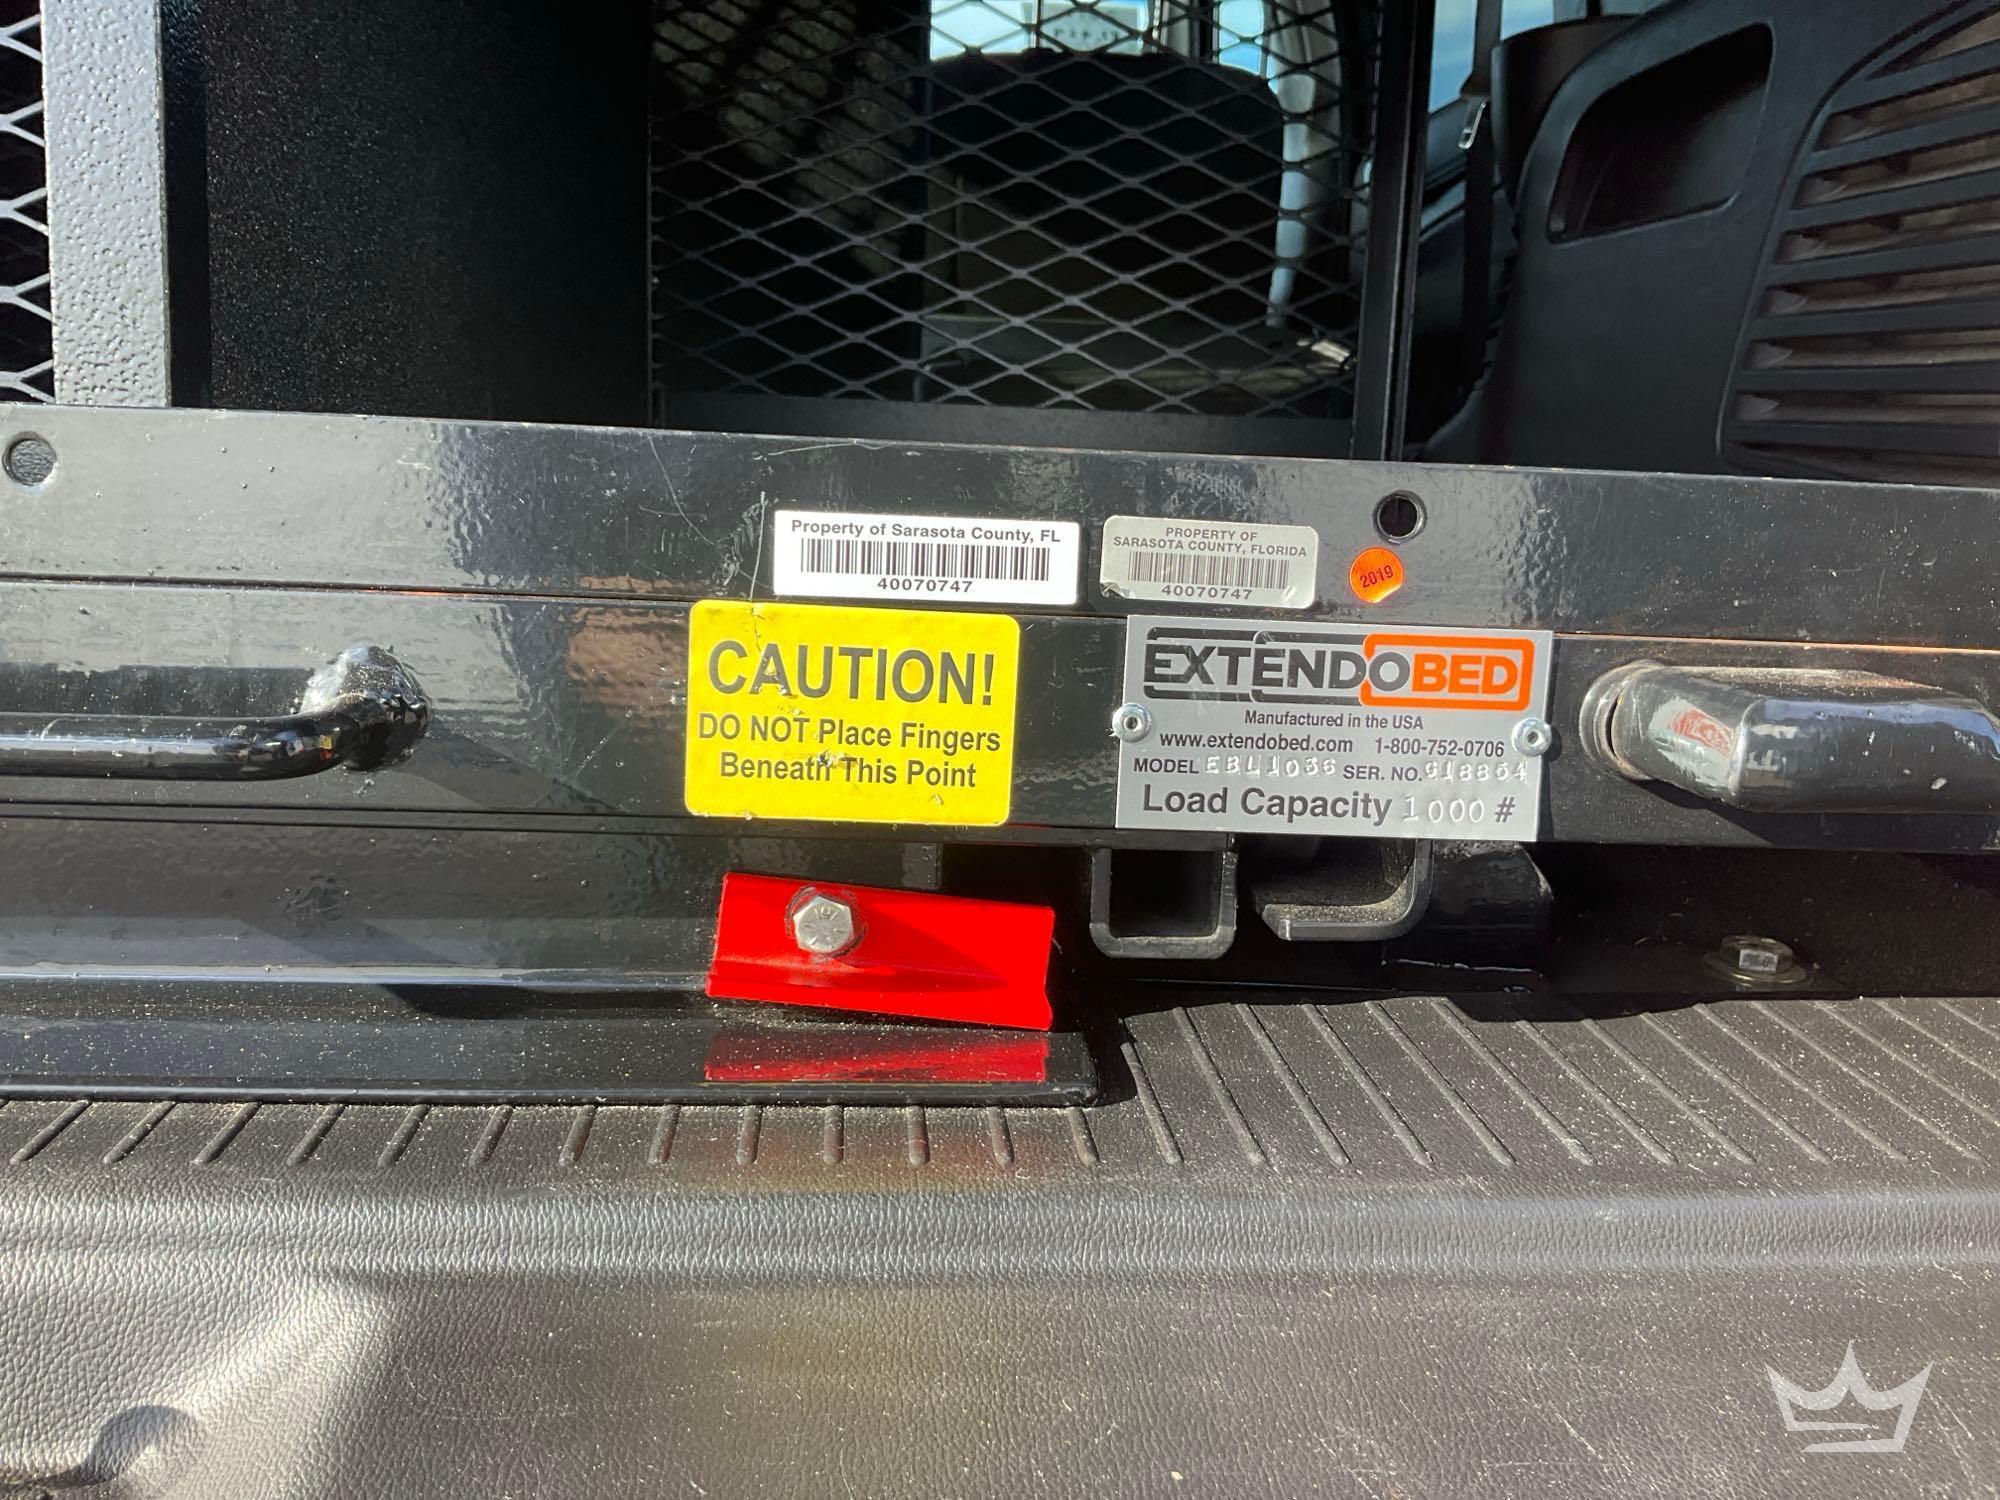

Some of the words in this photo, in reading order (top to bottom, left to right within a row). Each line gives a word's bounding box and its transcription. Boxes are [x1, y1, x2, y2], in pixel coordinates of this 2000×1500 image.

[791, 519, 864, 537] Property
[869, 523, 887, 536] of
[891, 523, 966, 539] Sarasota
[971, 527, 1035, 544] County,
[1040, 529, 1061, 542] FL
[1165, 527, 1236, 541] PROPERTY
[1239, 531, 1258, 541] OF
[1113, 536, 1184, 550] SARASOTA
[1188, 541, 1246, 554] COUNTY,
[1250, 544, 1307, 557] FLORIDA
[877, 578, 974, 593] 40070747
[1360, 564, 1394, 589] 2019
[1161, 584, 1253, 600] 40070747
[708, 640, 994, 706] CAUTION!
[1244, 709, 1343, 728] Manufactured
[1347, 713, 1360, 728] in
[1364, 714, 1388, 729] the
[1392, 716, 1424, 730] USA
[699, 712, 741, 740] DO
[750, 715, 810, 743] NOT
[818, 717, 892, 747] Place
[900, 721, 1001, 757] Fingers
[1159, 732, 1354, 753] www.extendobed.com
[1374, 739, 1505, 757] 1-800-752-0706
[720, 751, 831, 782] Beneath
[840, 756, 898, 785] This
[906, 759, 977, 788] Point
[1133, 757, 1199, 774] MODEL
[1343, 764, 1386, 781] SER.
[1391, 767, 1423, 782] NO.
[1143, 784, 1228, 816] Load
[1240, 787, 1393, 826] Capacity
[1403, 794, 1486, 823] 1000
[1494, 797, 1516, 824] #
